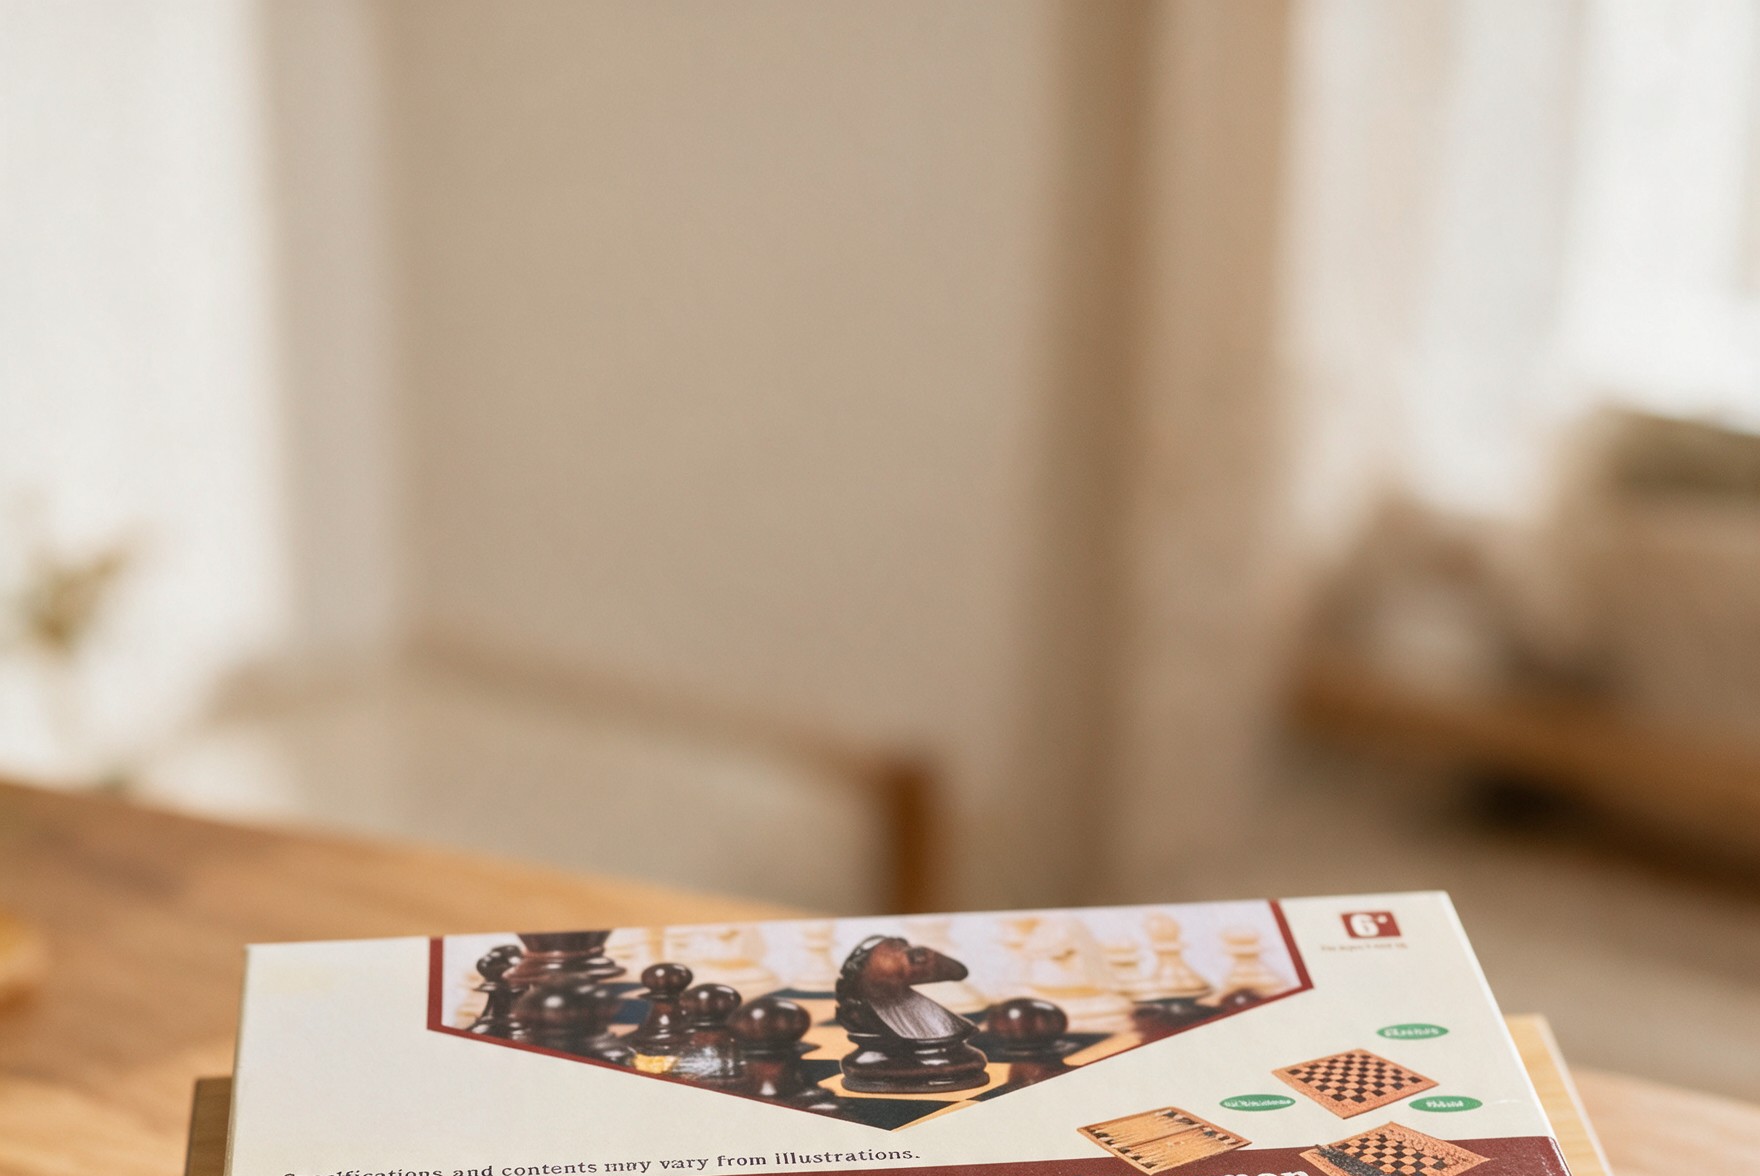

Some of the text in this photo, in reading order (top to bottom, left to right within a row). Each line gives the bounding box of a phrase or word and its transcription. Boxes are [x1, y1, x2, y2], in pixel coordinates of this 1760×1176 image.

[501, 1161, 598, 1176] contents
[660, 1157, 709, 1171] vary
[717, 1154, 767, 1167] from
[775, 1149, 921, 1166] illustrations.
